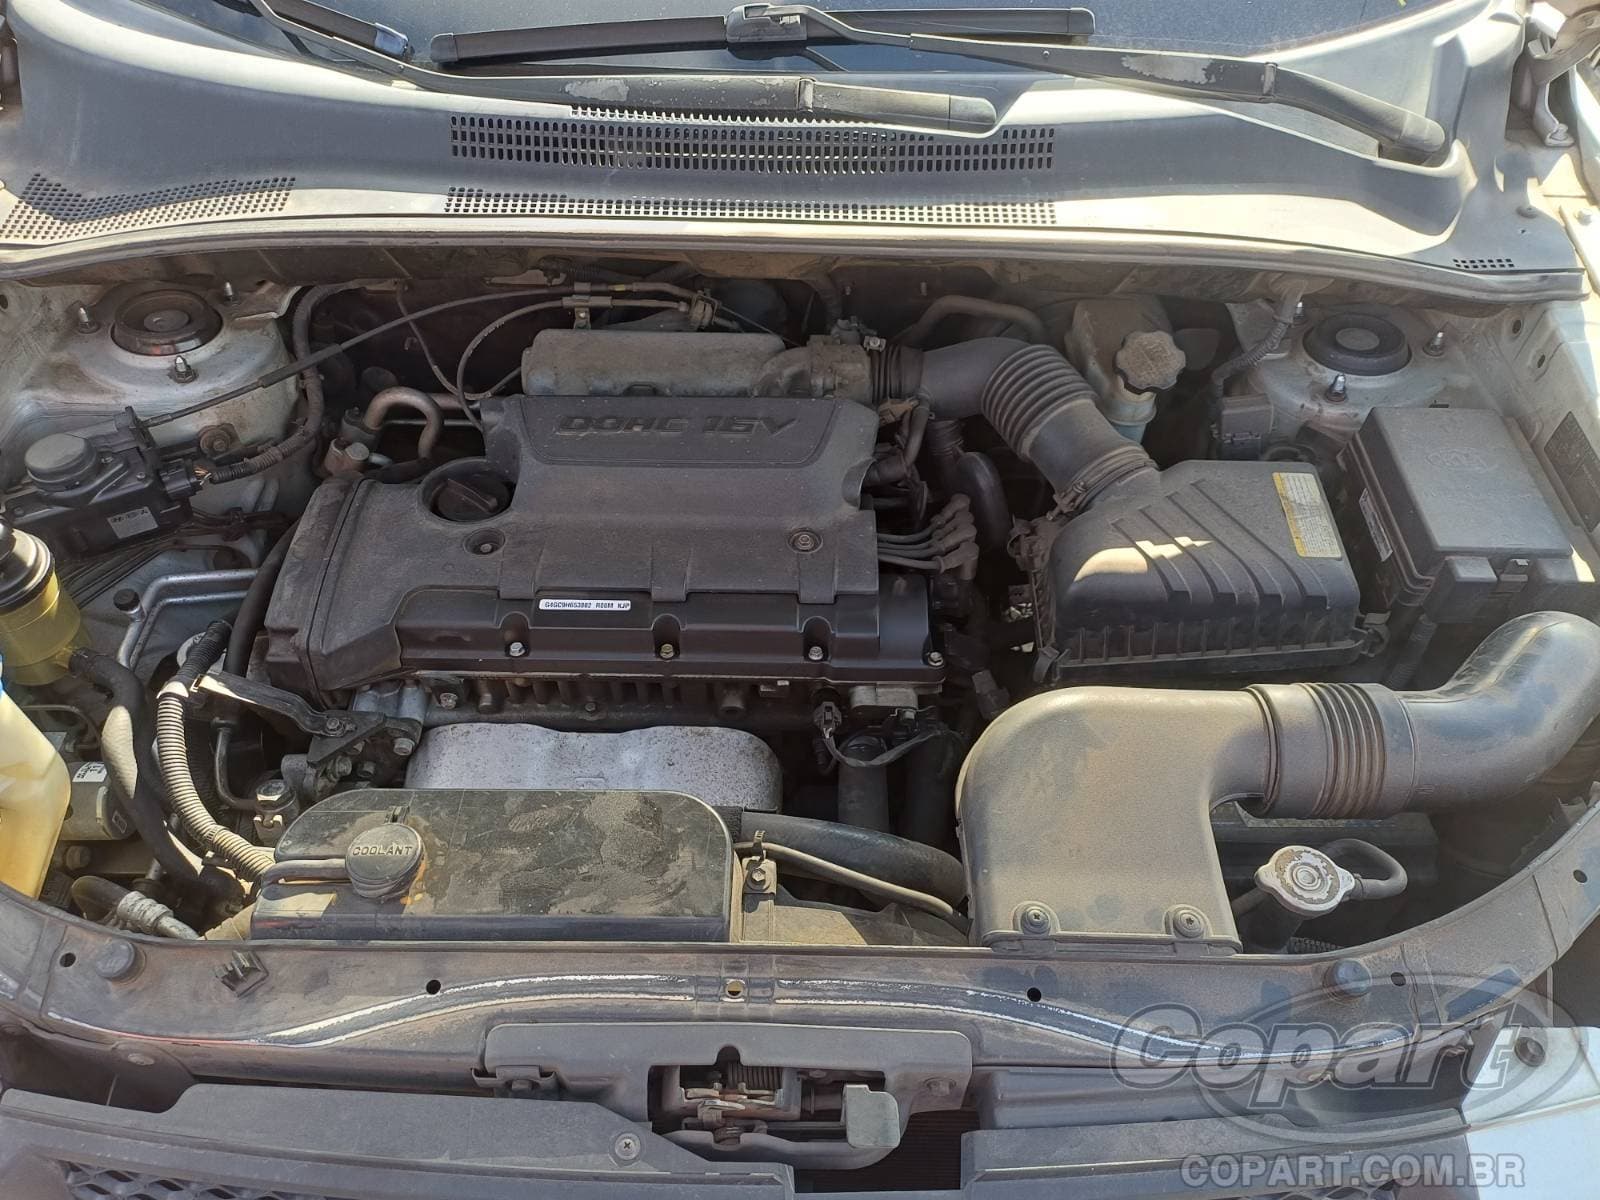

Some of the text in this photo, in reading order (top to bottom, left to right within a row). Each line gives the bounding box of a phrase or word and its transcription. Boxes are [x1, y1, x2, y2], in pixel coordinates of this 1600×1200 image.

[556, 415, 798, 437] DOHC 16V
[352, 845, 413, 856] COOLANT
